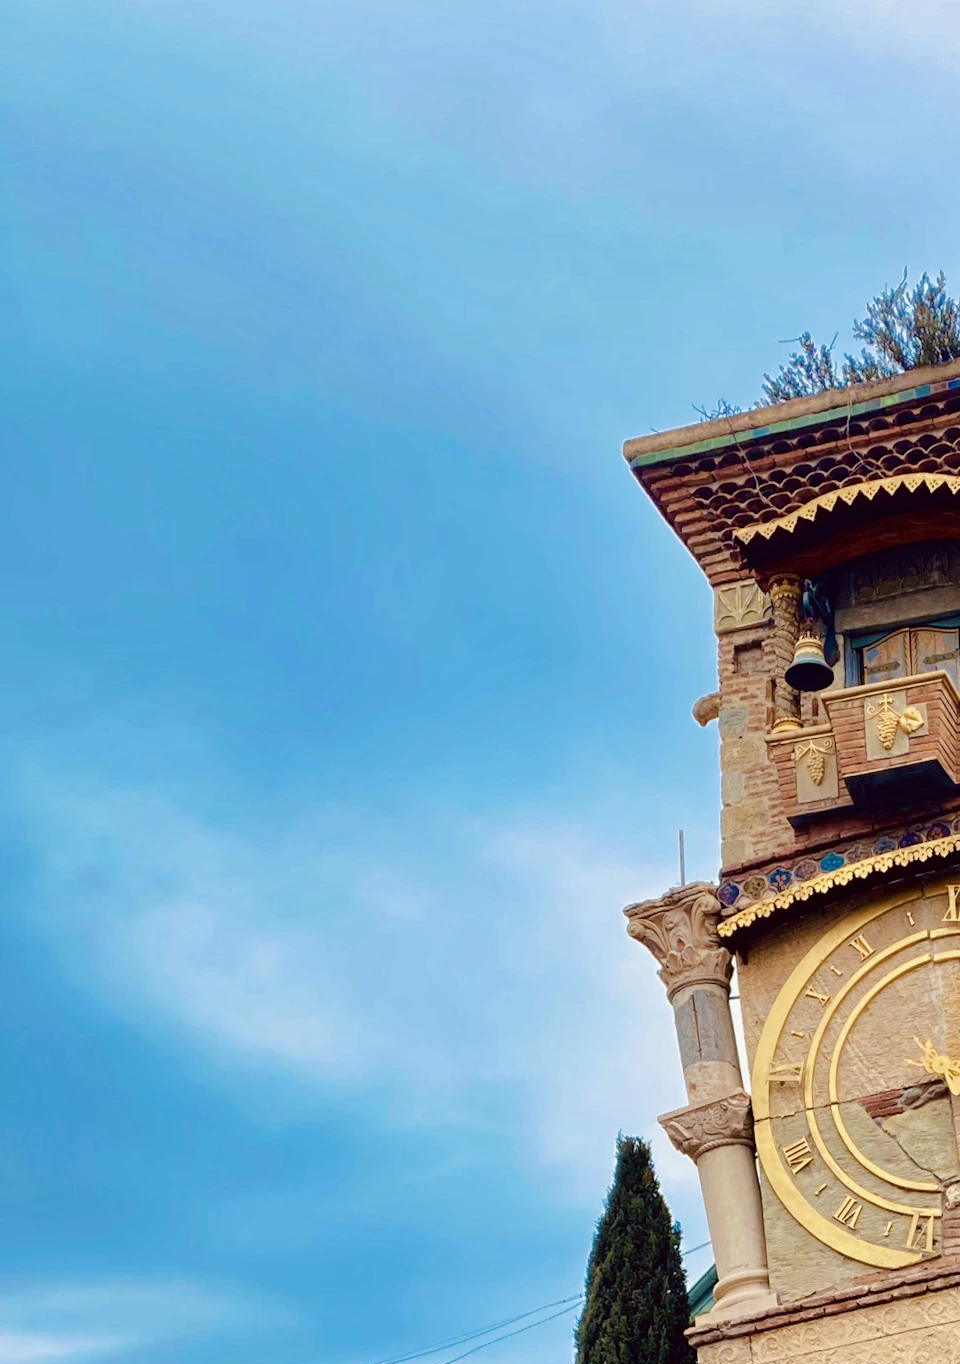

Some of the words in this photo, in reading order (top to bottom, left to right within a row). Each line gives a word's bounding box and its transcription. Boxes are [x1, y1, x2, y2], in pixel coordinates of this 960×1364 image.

[849, 933, 876, 962] XI
[806, 984, 830, 1006] X
[765, 1060, 805, 1085] IX
[782, 1136, 813, 1175] VIII
[832, 1195, 863, 1230] VII
[901, 1209, 937, 1253] VI
